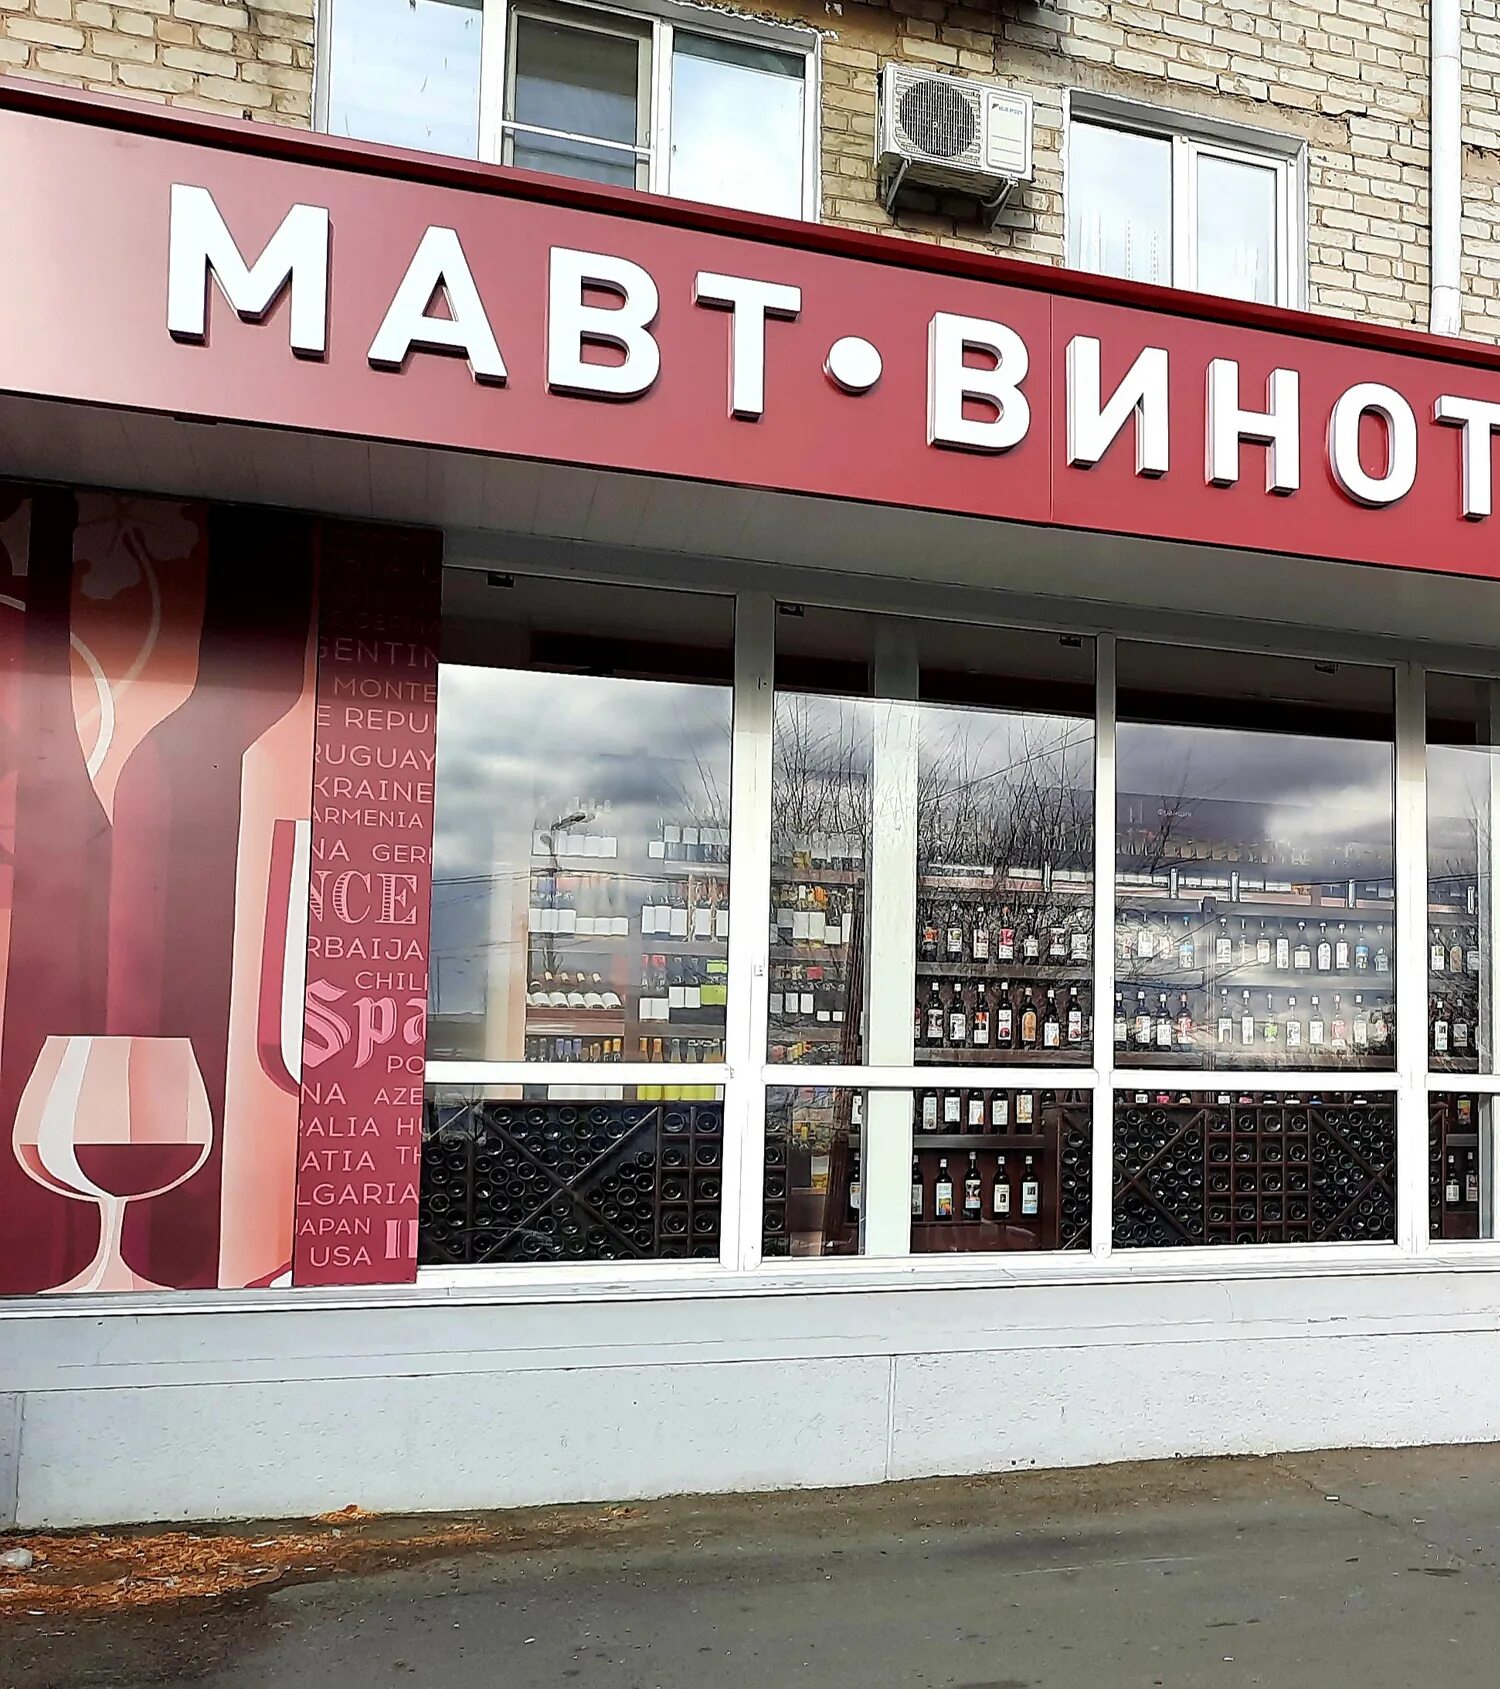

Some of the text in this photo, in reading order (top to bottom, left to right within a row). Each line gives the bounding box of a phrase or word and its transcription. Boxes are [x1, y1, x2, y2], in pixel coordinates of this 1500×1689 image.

[167, 183, 802, 421] МАВТ
[334, 679, 437, 703] MONTE
[345, 707, 436, 733] REPU
[372, 844, 432, 865] GER
[355, 971, 428, 991] CHIL
[373, 1087, 423, 1105] AZE
[300, 1116, 381, 1137] ALIA
[301, 1150, 376, 1171] ATIA
[297, 1183, 419, 1206] LGARIA
[310, 1246, 372, 1267] USA
